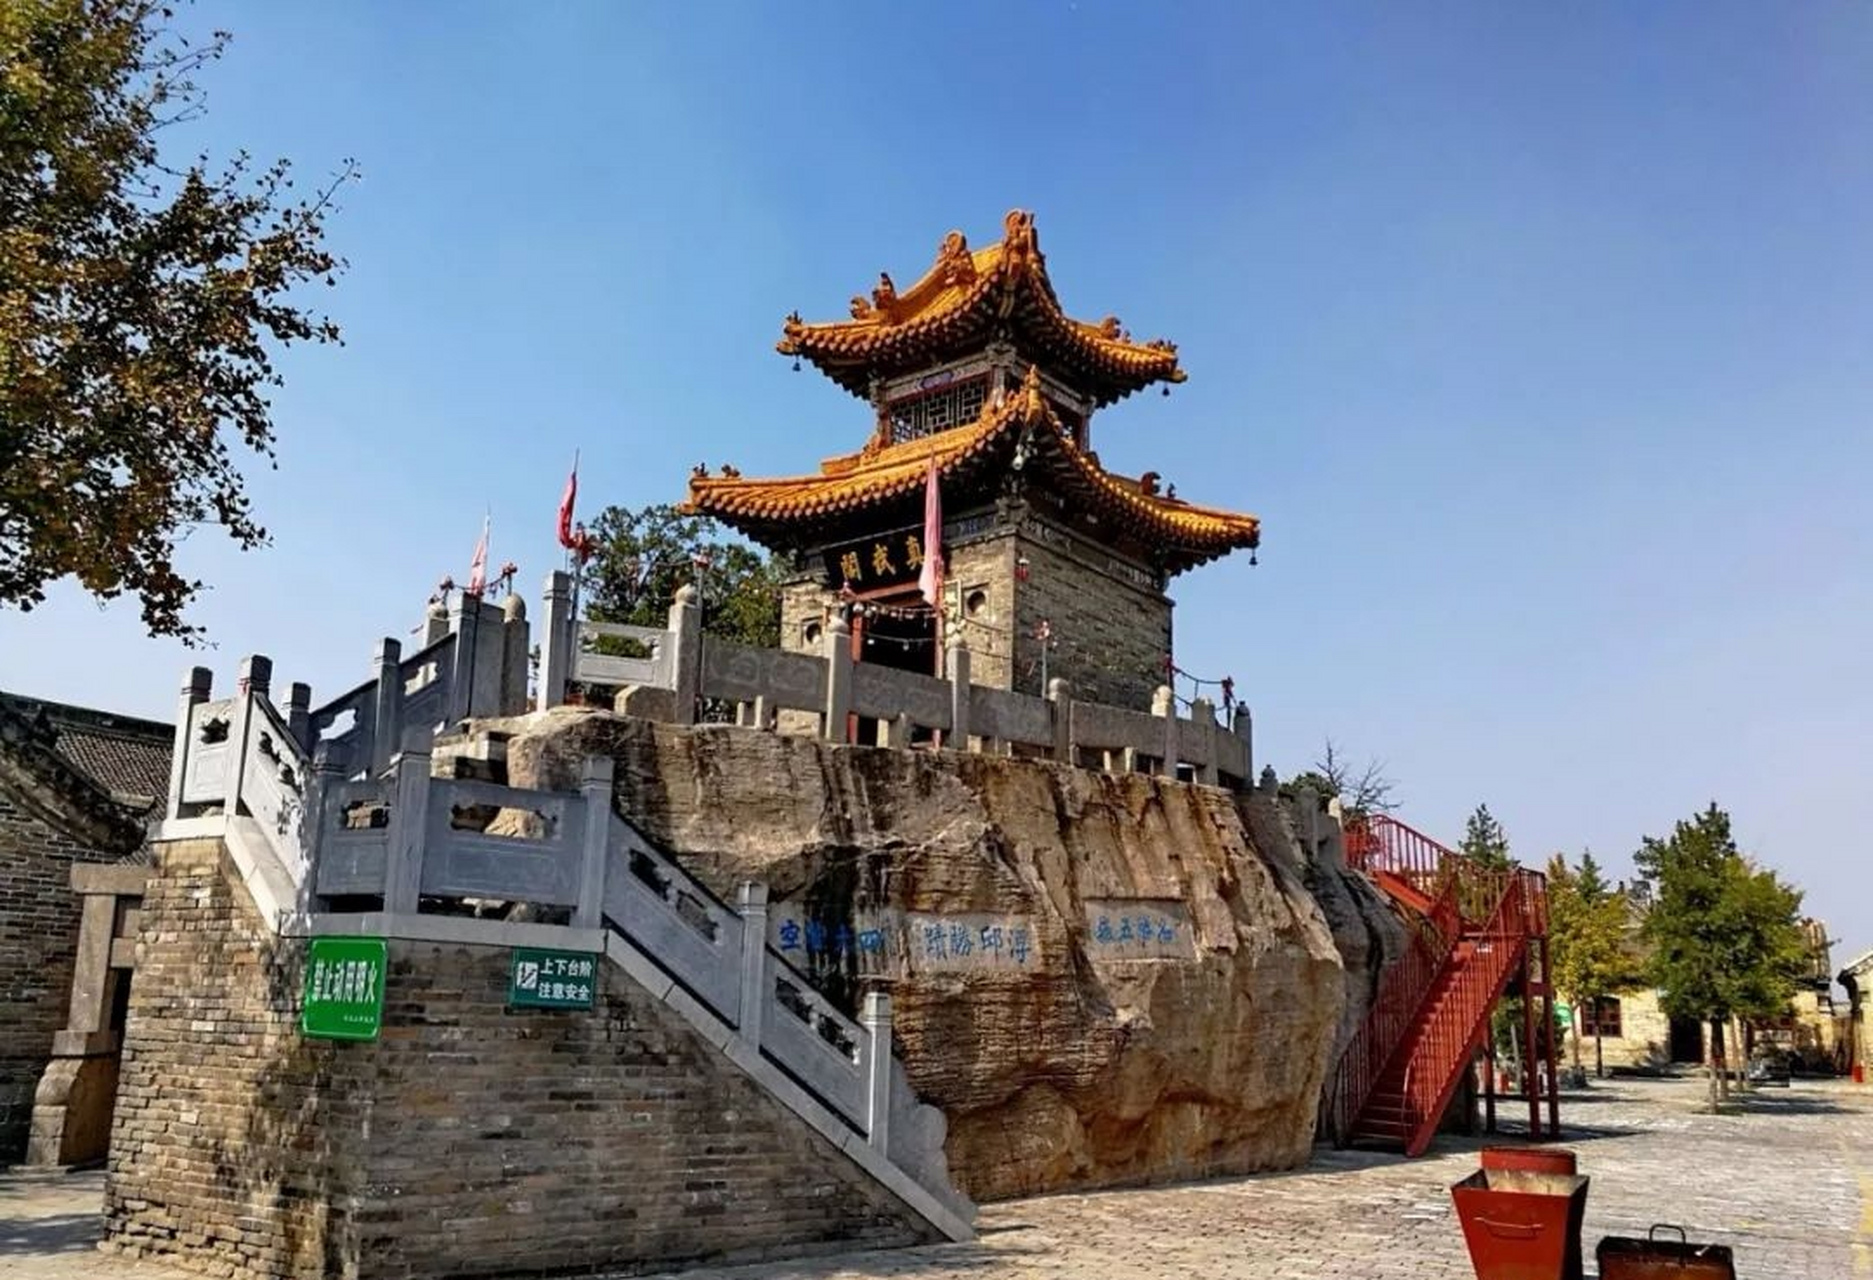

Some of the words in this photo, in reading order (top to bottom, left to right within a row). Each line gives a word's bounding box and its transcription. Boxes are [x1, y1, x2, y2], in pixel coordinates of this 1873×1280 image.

[539, 957, 592, 978] 上下台阶
[311, 957, 378, 1004] 禁止动用明火
[538, 981, 591, 1001] 注意安全
